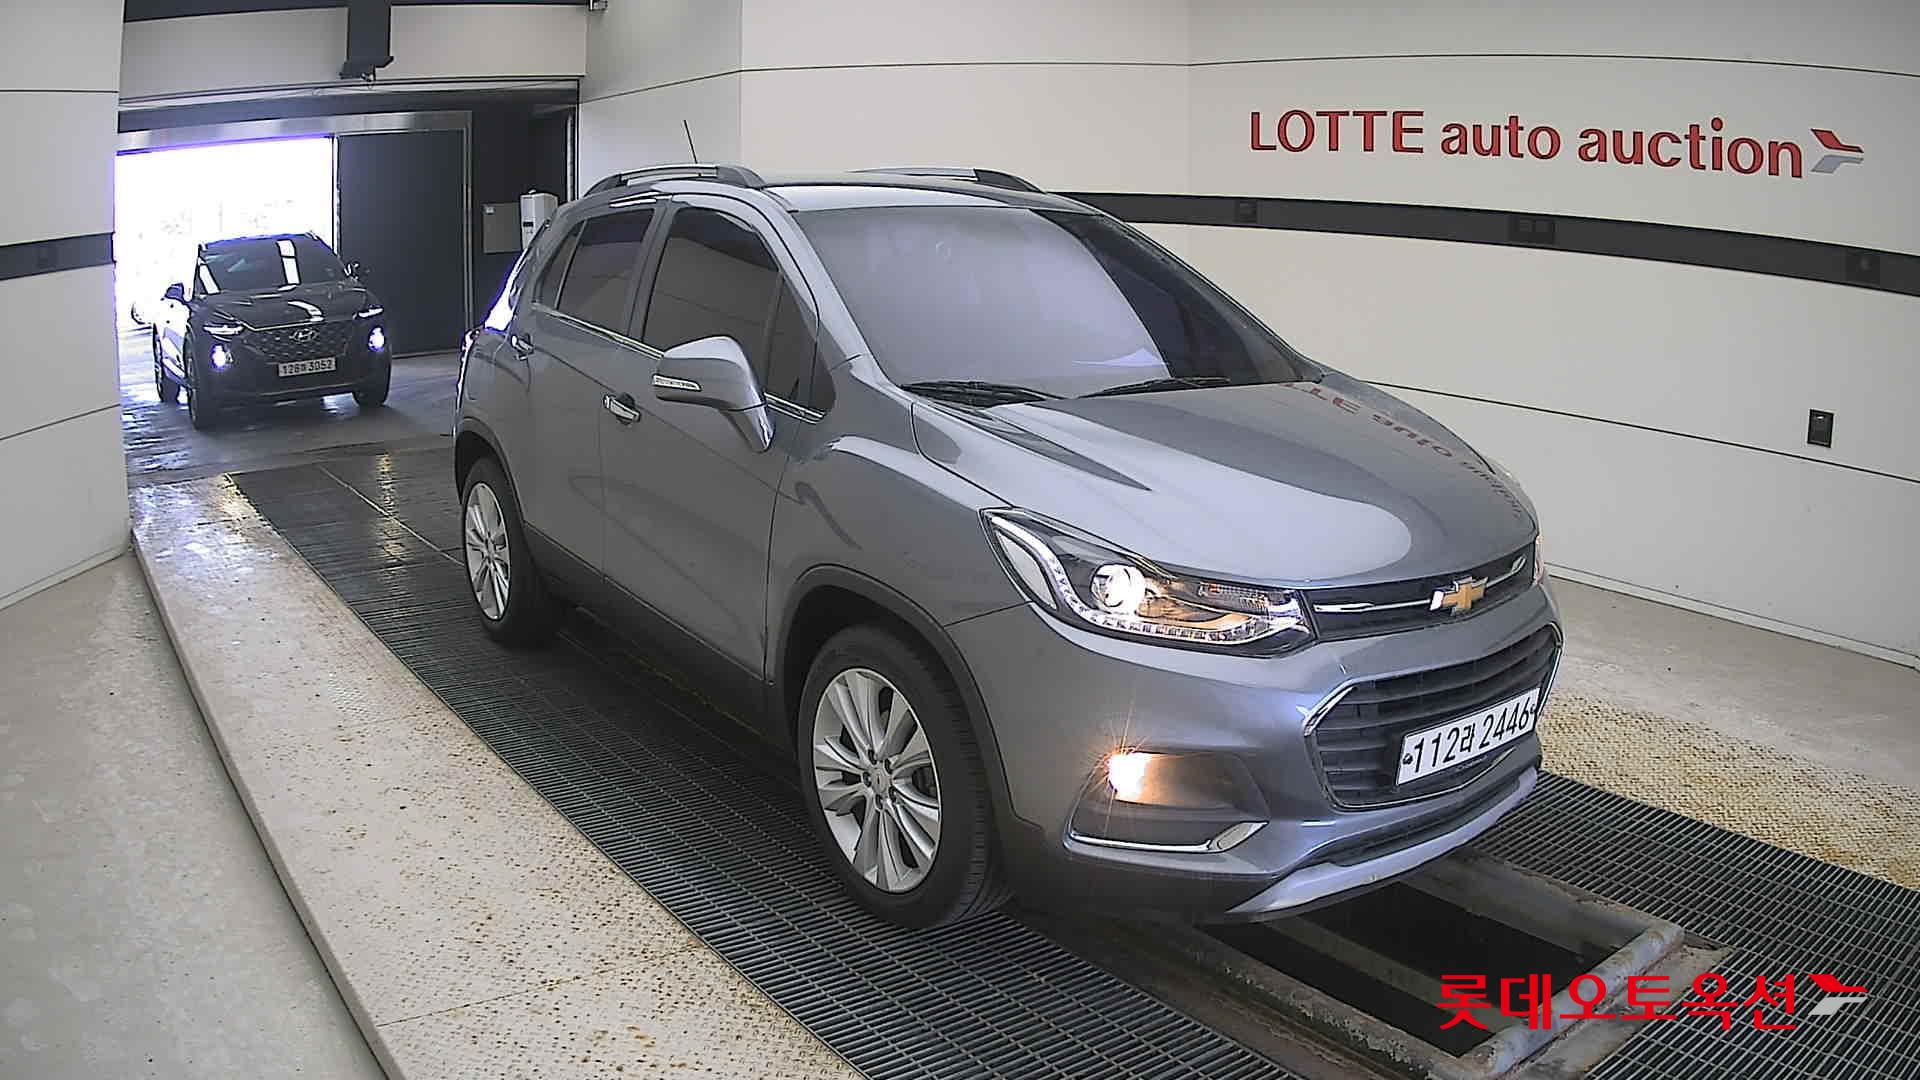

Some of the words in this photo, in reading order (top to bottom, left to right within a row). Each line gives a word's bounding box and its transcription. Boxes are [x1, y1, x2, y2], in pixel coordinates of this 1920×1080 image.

[1249, 109, 1425, 154] LOTTE
[1440, 114, 1562, 160] auto
[1578, 116, 1804, 179] auction
[1414, 722, 1476, 773] 112라
[1478, 696, 1532, 750] 2446
